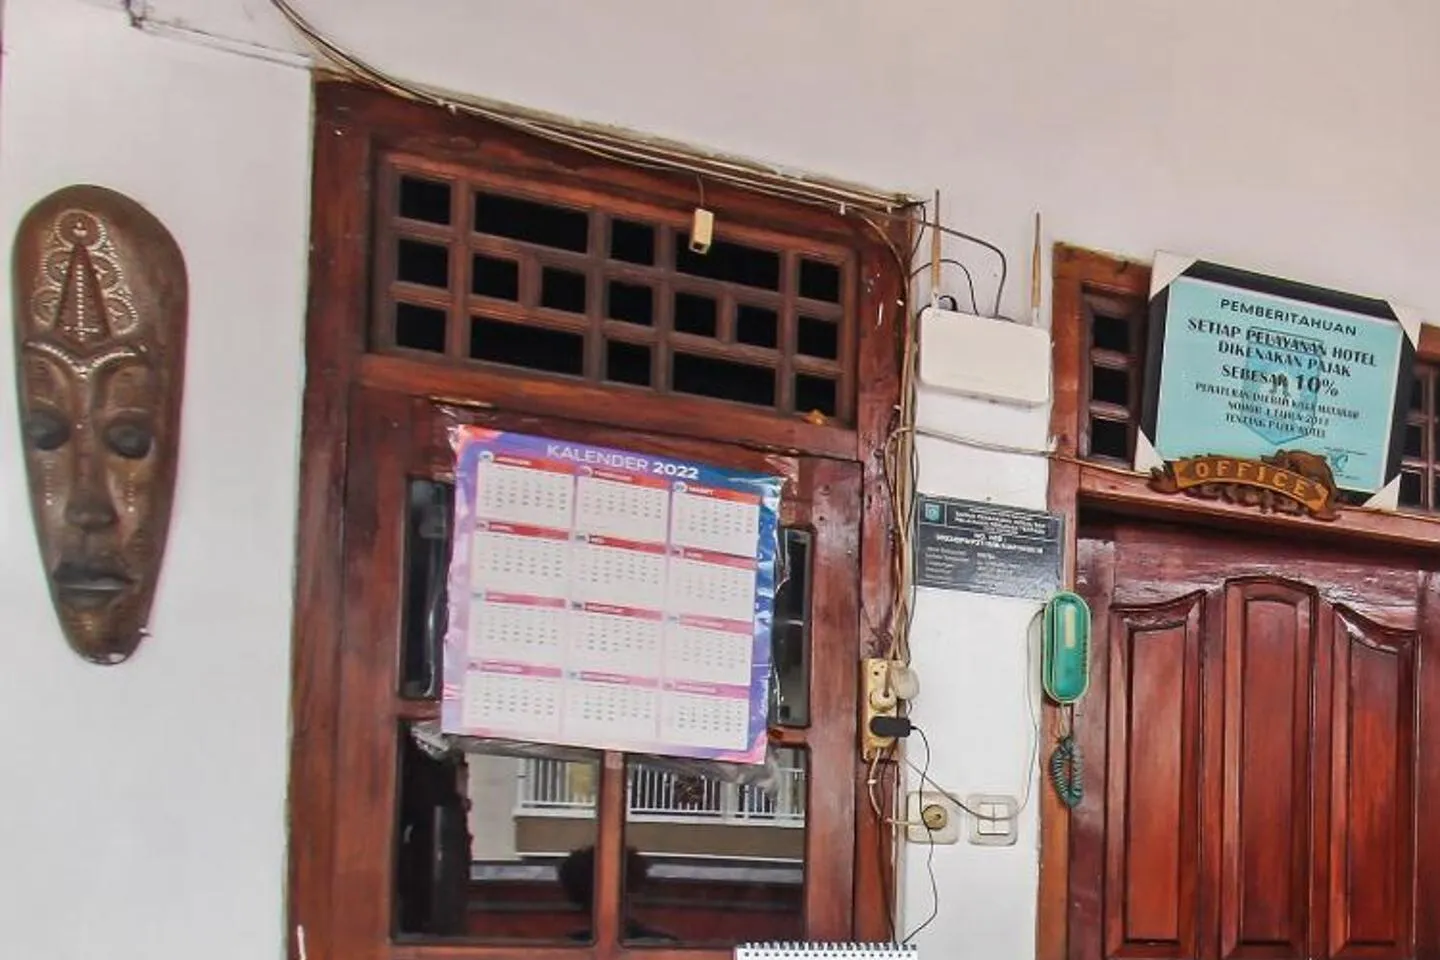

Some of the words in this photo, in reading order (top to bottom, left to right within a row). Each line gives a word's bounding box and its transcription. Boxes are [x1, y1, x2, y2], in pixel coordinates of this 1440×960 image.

[1220, 298, 1357, 337] PEMBERITAHUAN
[1187, 317, 1241, 339] SETIAP
[1246, 330, 1327, 357] PELAYANAN
[1331, 346, 1378, 367] HOTEL
[1218, 340, 1303, 369] DIKENAKAN
[1307, 352, 1352, 377] PAJAK
[1221, 364, 1288, 388] SEBESAR
[1295, 373, 1339, 397] 10%
[546, 443, 650, 473] KALENDER
[651, 461, 700, 480] 2022
[1194, 458, 1308, 496] OFFICE
